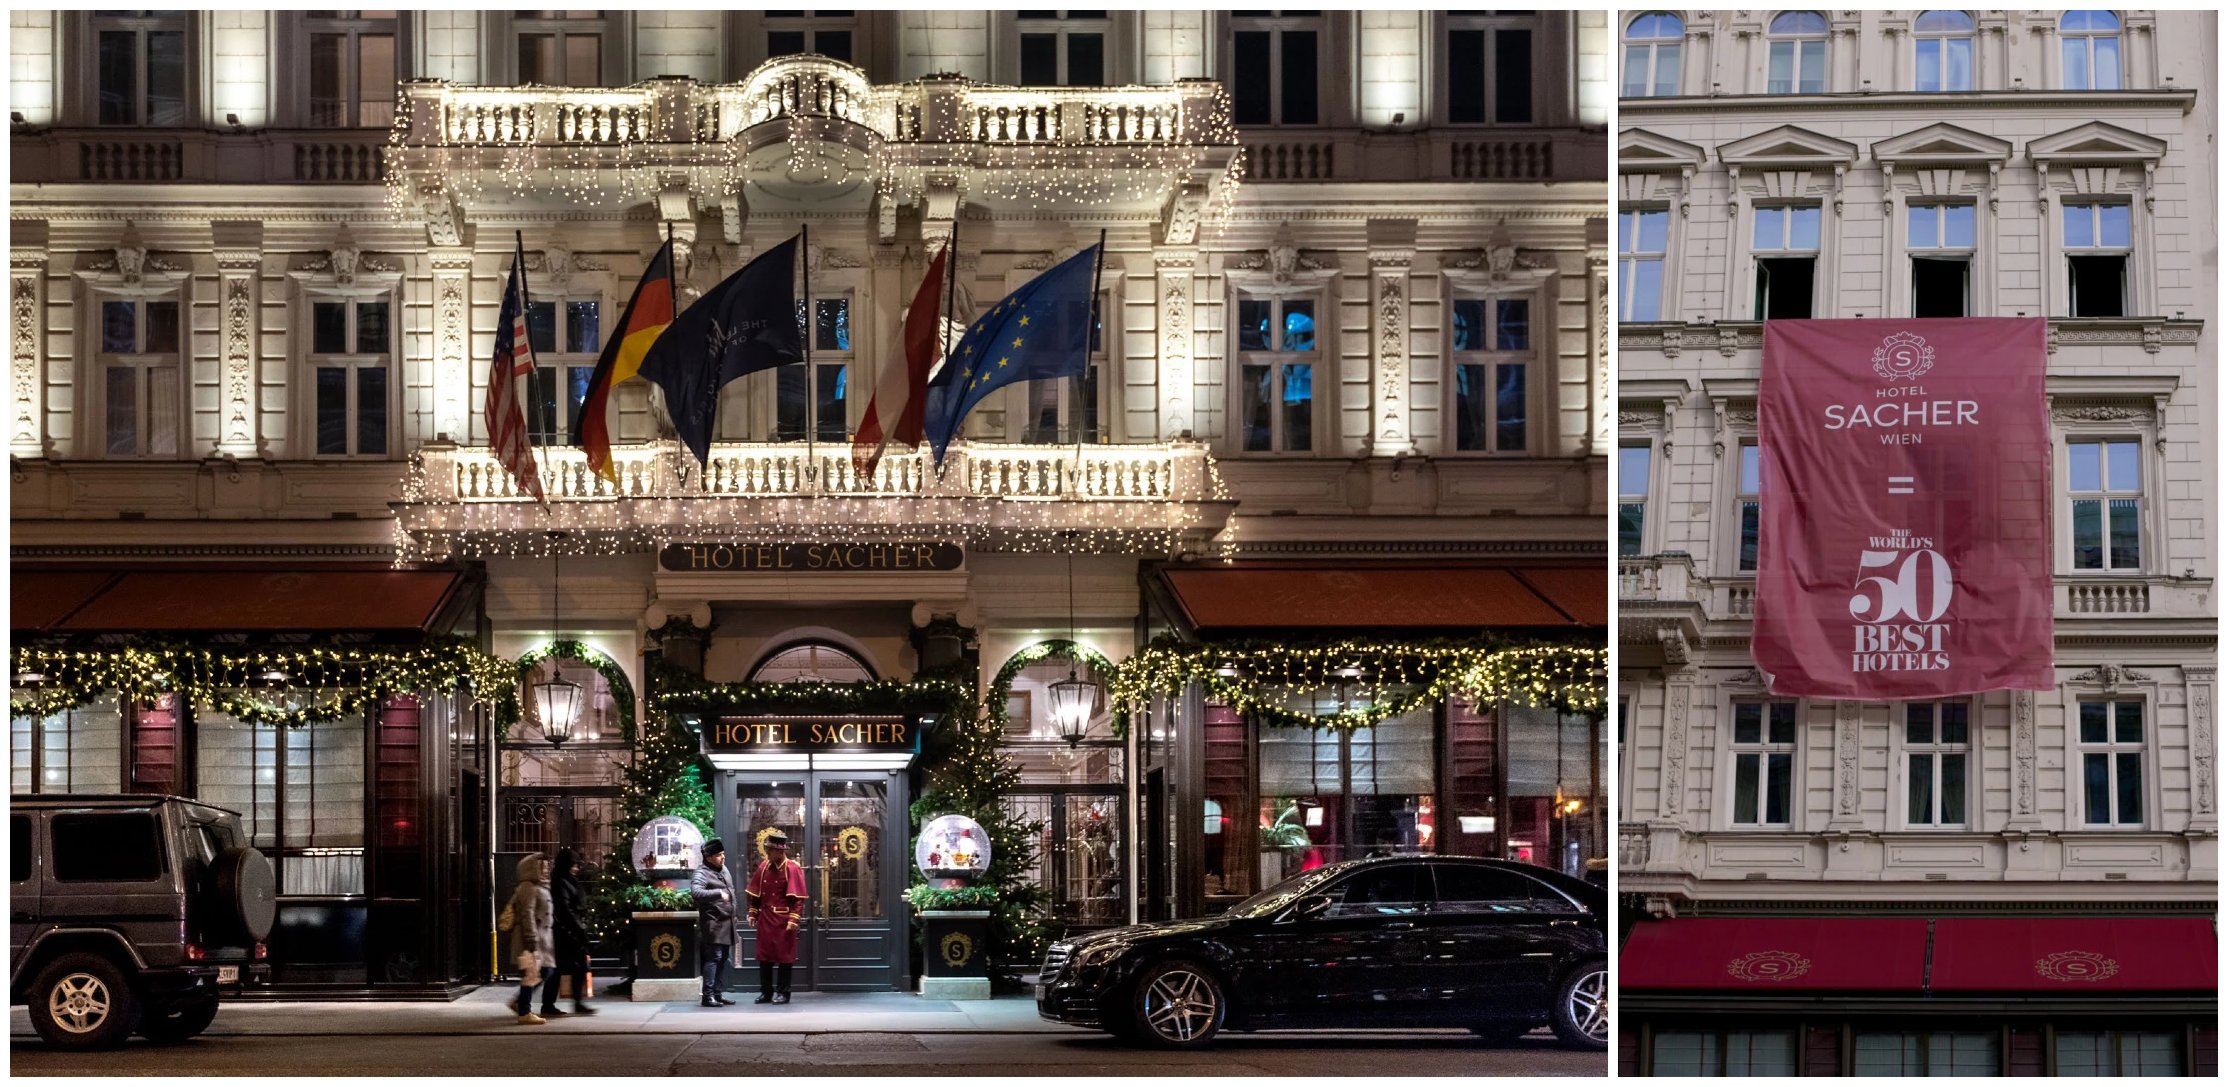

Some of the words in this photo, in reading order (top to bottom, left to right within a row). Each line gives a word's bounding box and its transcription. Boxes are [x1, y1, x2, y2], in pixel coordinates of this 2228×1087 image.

[1876, 386, 1928, 398] HOTEL
[1824, 400, 1979, 430] SACHER
[1880, 433, 1922, 445] WIEN
[1869, 537, 1933, 548] WORLD'S
[1890, 528, 1912, 537] THE
[691, 546, 793, 568] HOTEL
[808, 546, 936, 568] SACHER
[1849, 549, 1953, 623] 50
[1852, 624, 1949, 653] BEST
[1853, 653, 1950, 672] HOTELS
[715, 724, 797, 744] HOTEL
[811, 723, 906, 744] SACHER
